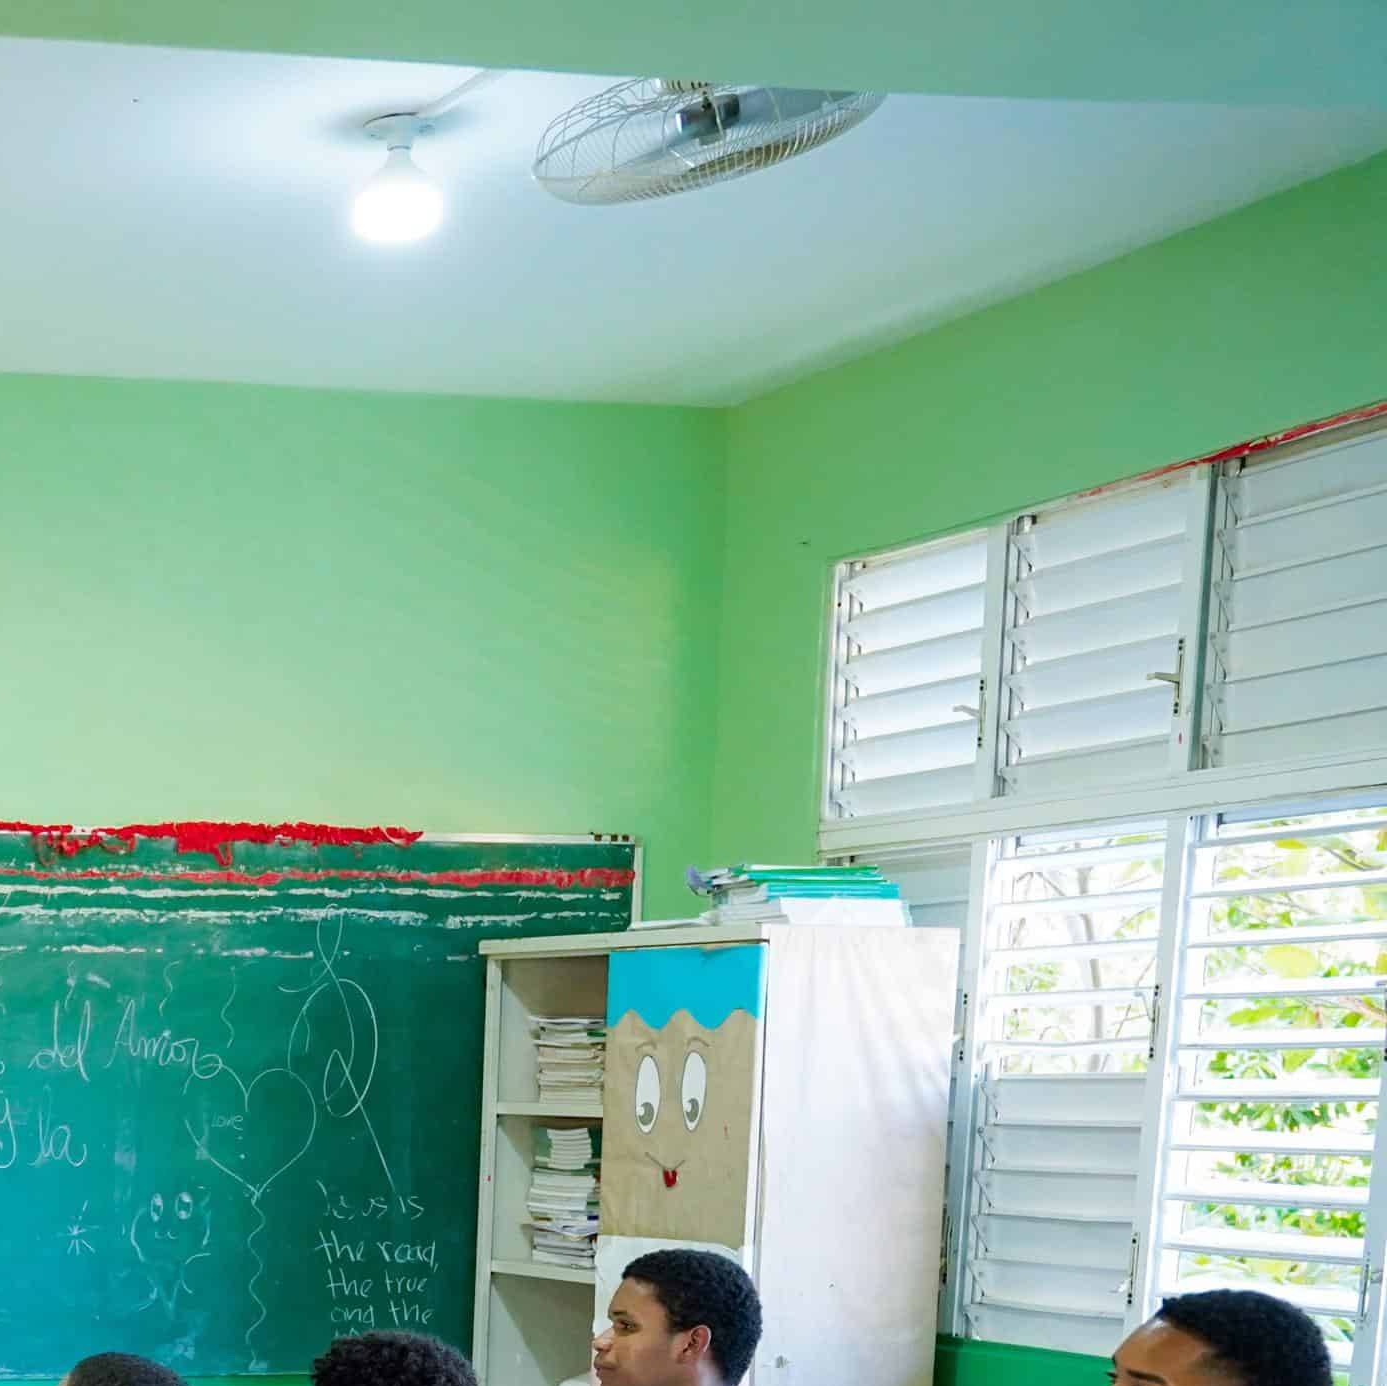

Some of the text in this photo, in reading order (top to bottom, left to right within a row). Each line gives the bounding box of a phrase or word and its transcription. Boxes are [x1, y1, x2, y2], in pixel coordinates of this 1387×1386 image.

[27, 1000, 90, 1082] del
[315, 1230, 366, 1264] the
[326, 1267, 428, 1300] the true
[388, 1299, 436, 1327] the
